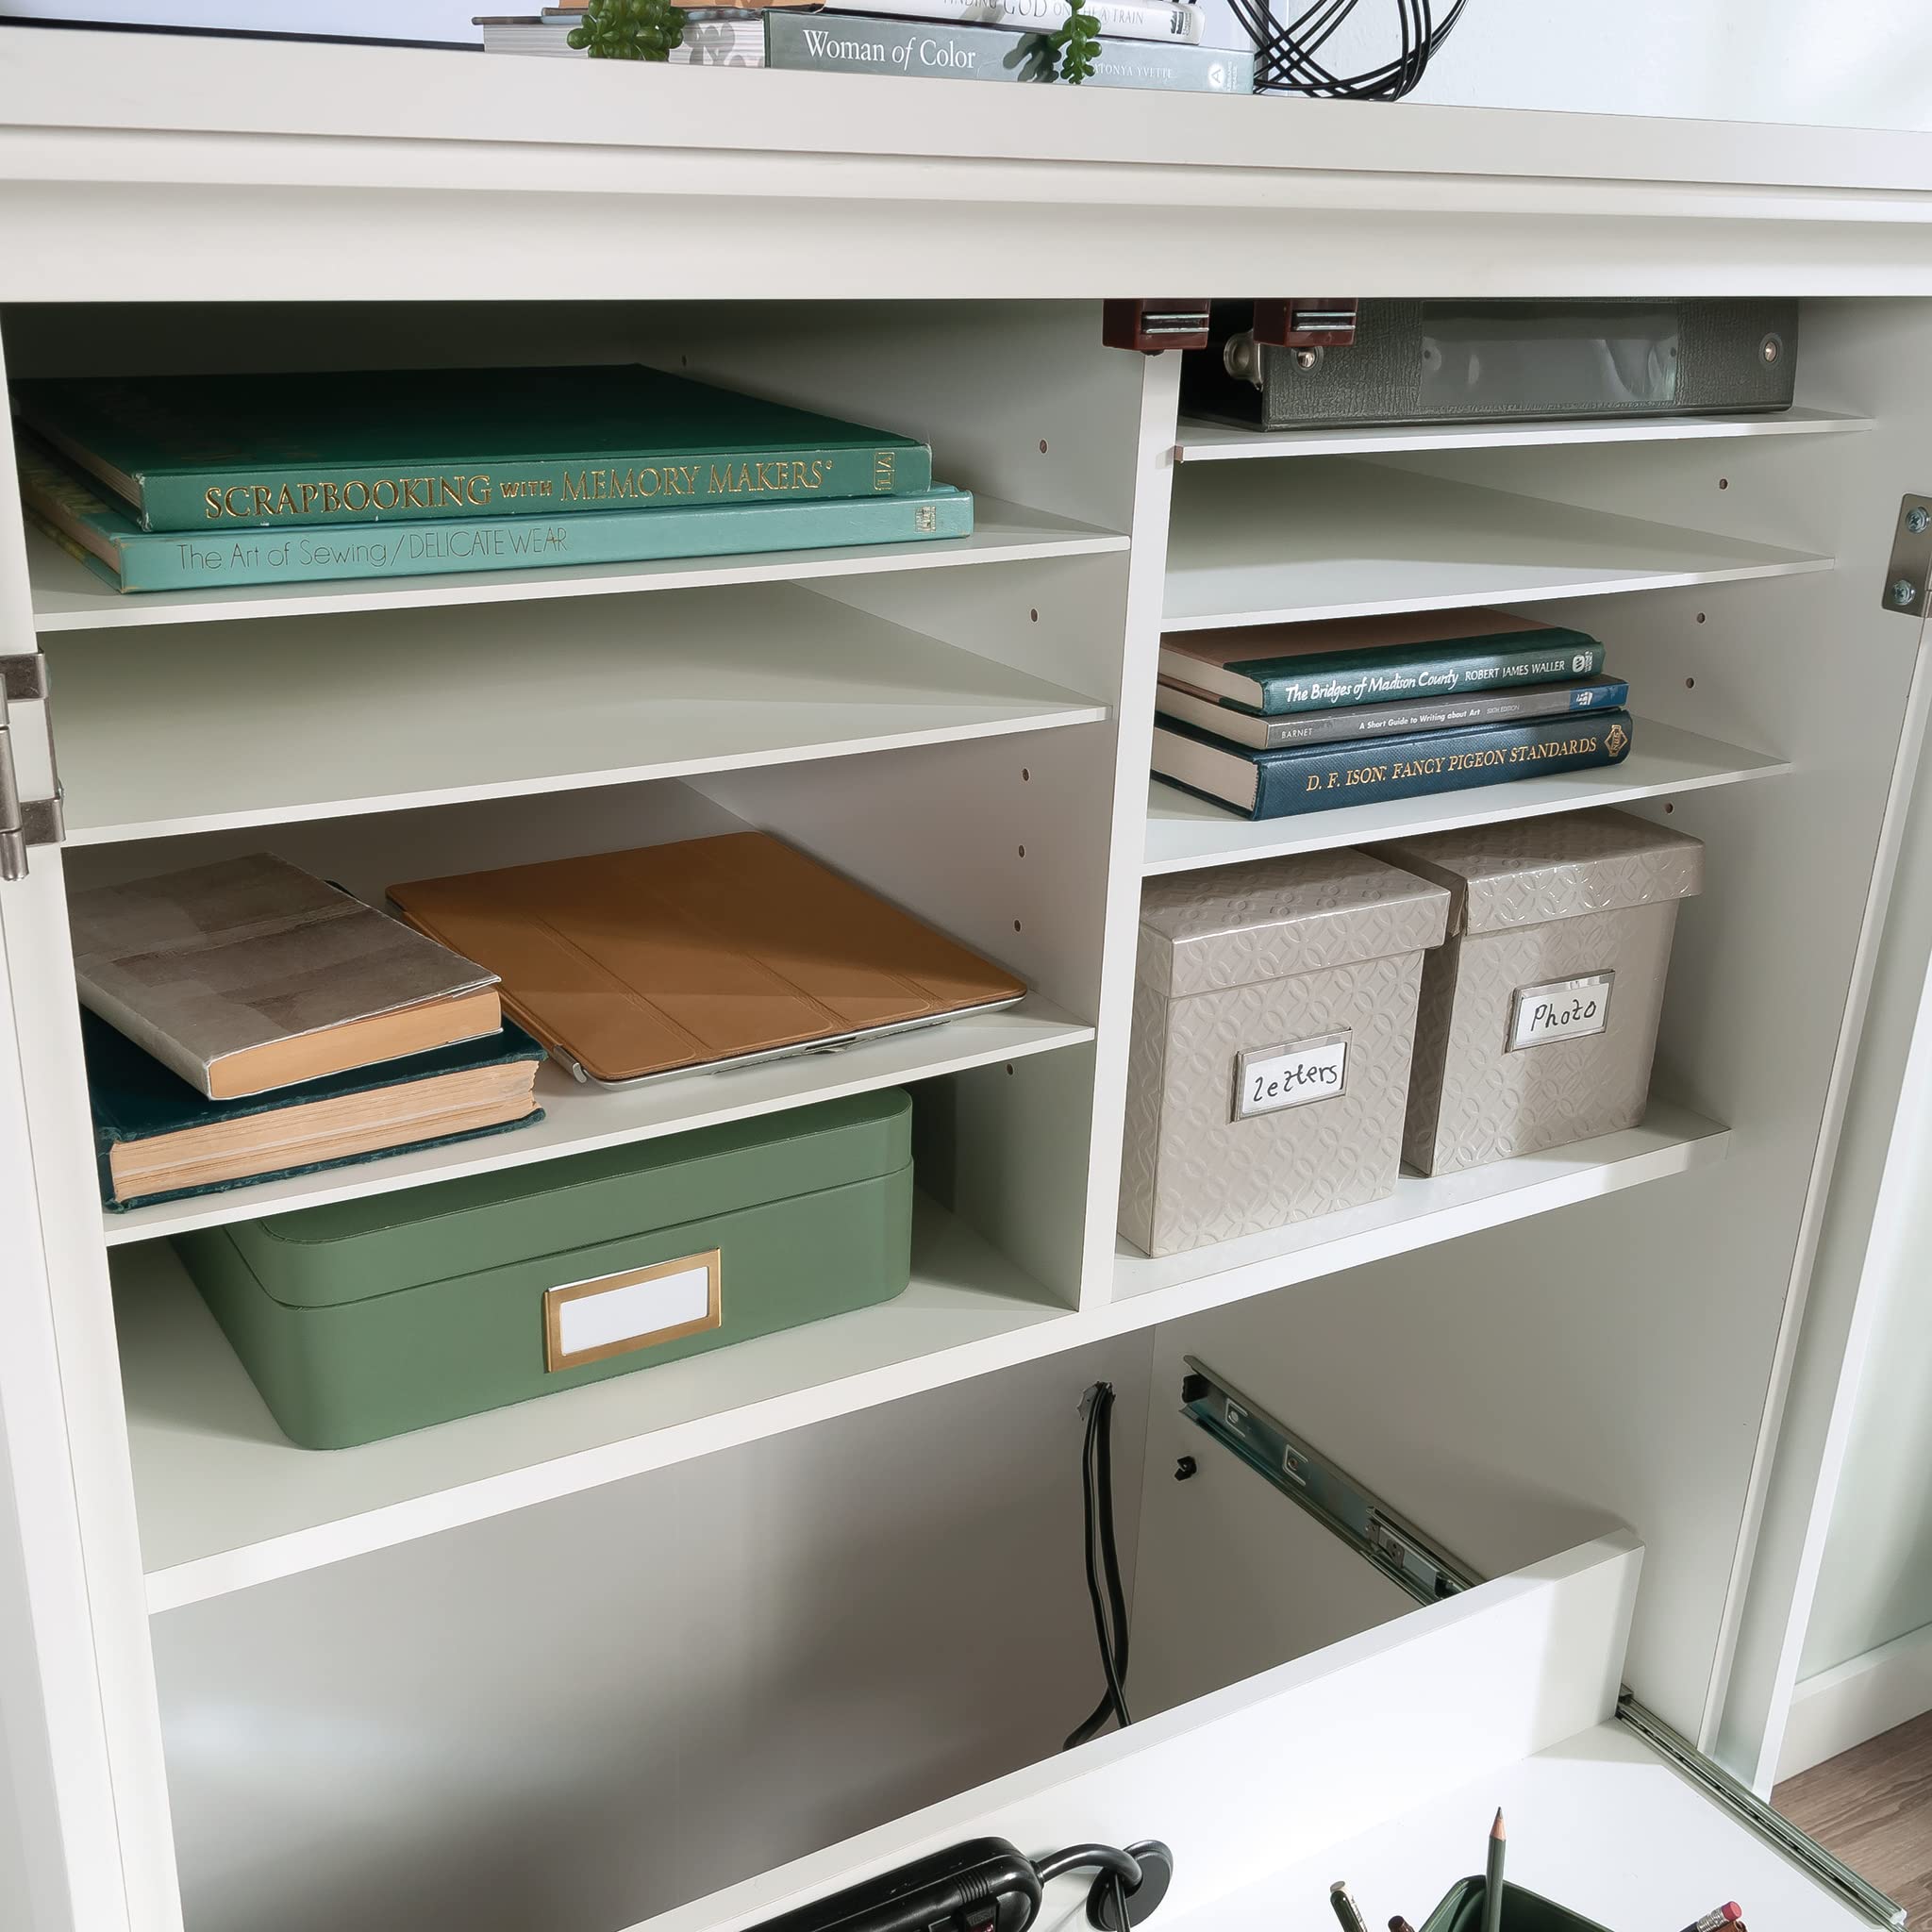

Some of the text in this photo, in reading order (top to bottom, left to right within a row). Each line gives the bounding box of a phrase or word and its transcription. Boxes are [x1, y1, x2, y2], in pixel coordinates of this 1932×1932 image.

[1003, 0, 1048, 18] GOD
[1112, 8, 1143, 25] TRAIN
[802, 29, 976, 72] Woman of Color
[1093, 62, 1173, 79] ATONYA YVETTE
[204, 475, 492, 520] SCRAPBOOKING
[560, 465, 702, 502] MEMORY
[176, 543, 223, 570] The
[230, 542, 259, 568] Art
[267, 541, 291, 567] of
[508, 526, 568, 555] WEAR
[1464, 660, 1565, 682] ROBERT JAMES WALLER
[1285, 669, 1459, 703] The Bridges of Madison County
[1367, 720, 1387, 729] Short
[1388, 717, 1408, 726] Guide
[1409, 715, 1419, 724] to
[1419, 712, 1446, 724] Writing
[1446, 709, 1468, 720] about
[1469, 708, 1481, 717] Art
[1281, 727, 1313, 740] BARNET
[1306, 774, 1323, 792] D.
[1326, 772, 1341, 789] F.
[1391, 757, 1446, 780] FANCY
[1447, 748, 1508, 773] PIGEON
[1509, 736, 1598, 763] STANDARDS
